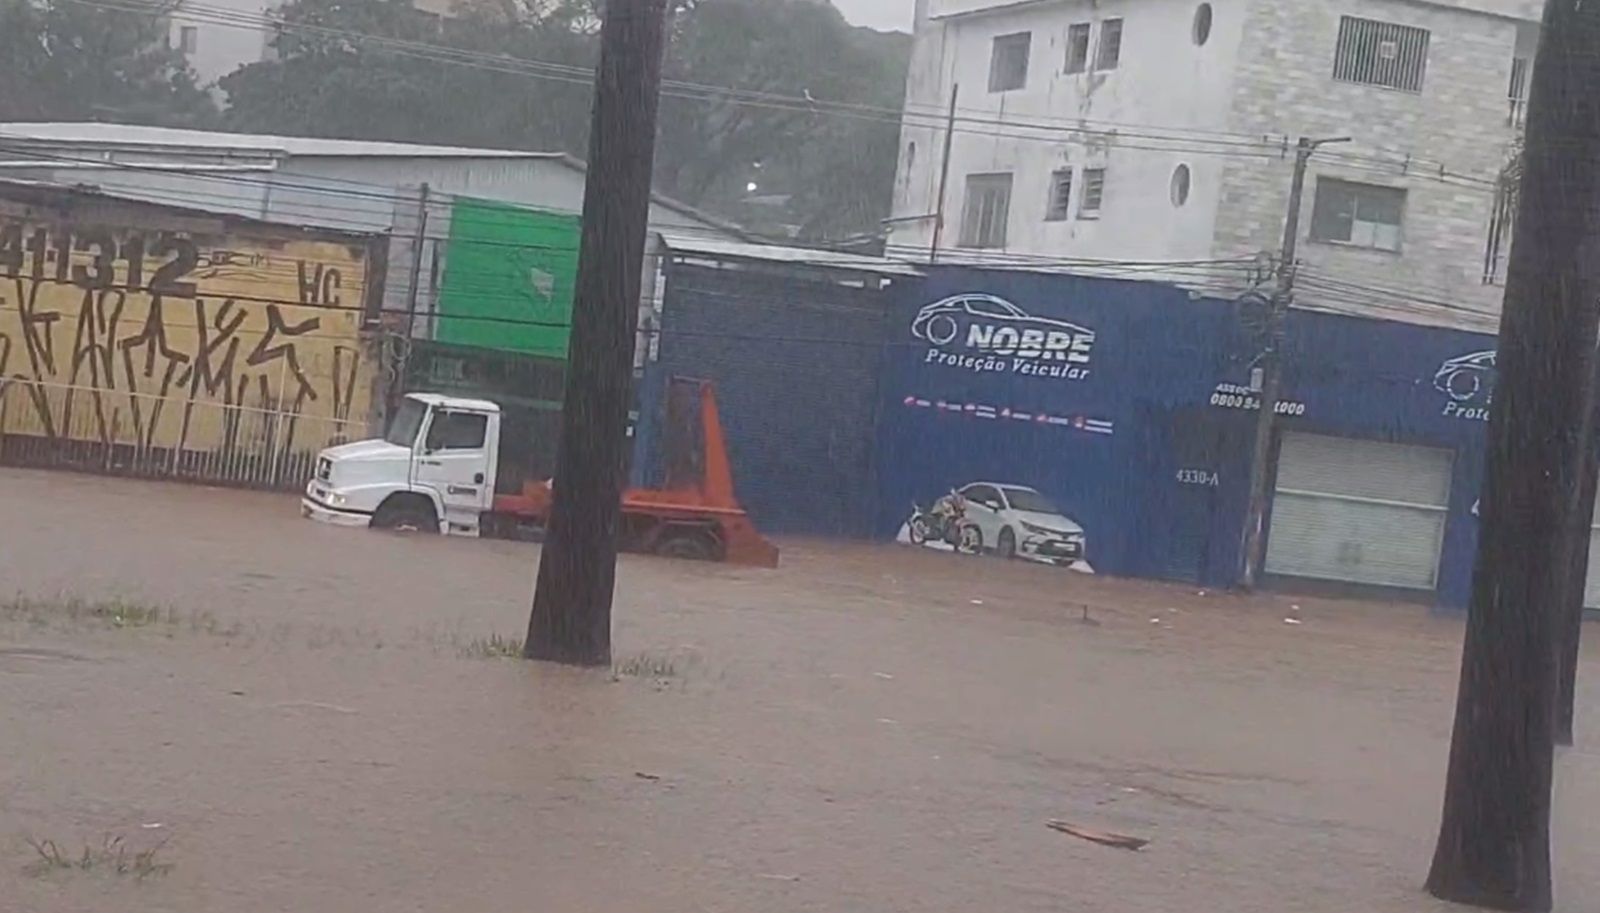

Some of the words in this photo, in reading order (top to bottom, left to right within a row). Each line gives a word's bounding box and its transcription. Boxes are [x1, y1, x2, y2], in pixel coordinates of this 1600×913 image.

[965, 323, 1096, 363] NOBRE
[925, 348, 1005, 372] Proteção
[1012, 358, 1090, 381] Veicular
[1176, 469, 1219, 486] 4330-A
